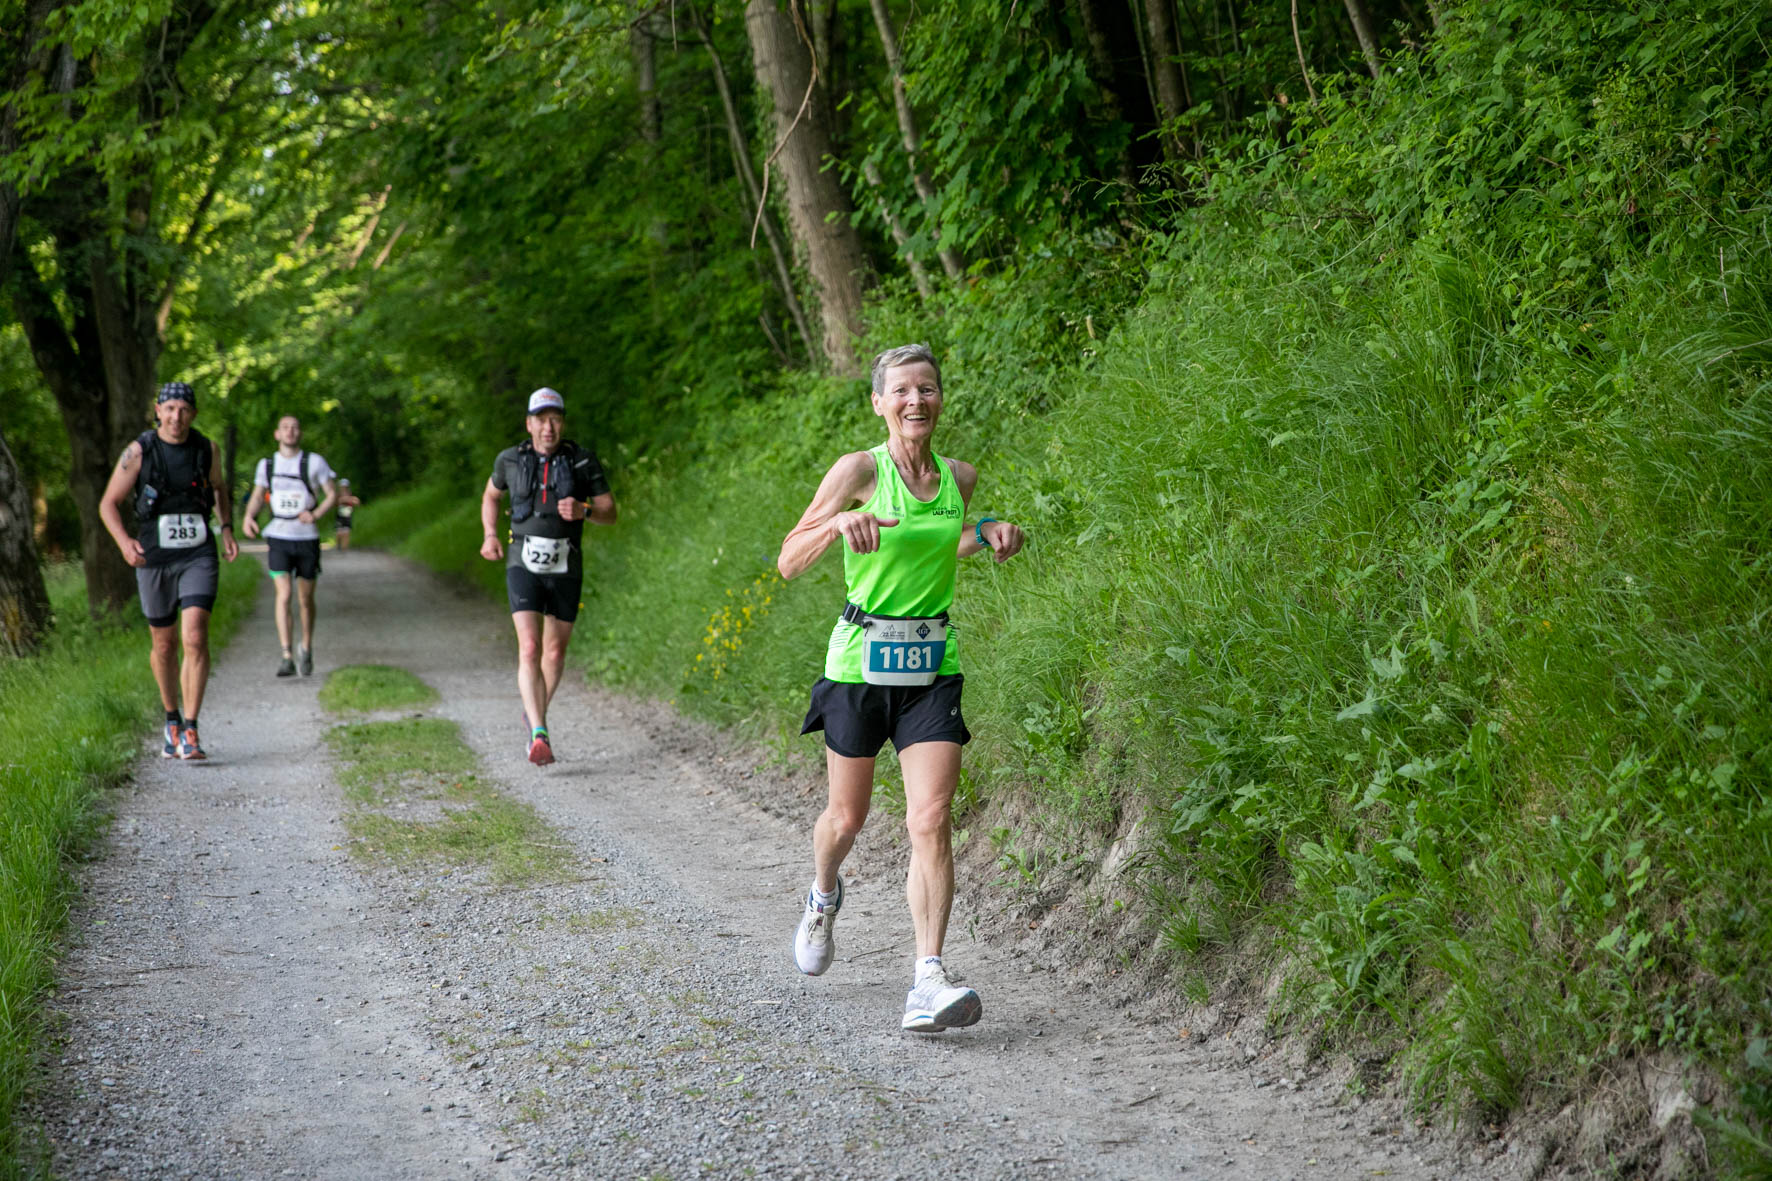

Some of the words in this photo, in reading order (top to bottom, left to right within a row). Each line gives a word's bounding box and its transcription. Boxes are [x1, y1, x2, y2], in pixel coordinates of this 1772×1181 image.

[169, 527, 196, 540] 283
[530, 551, 560, 564] 224
[880, 646, 932, 669] 1181
